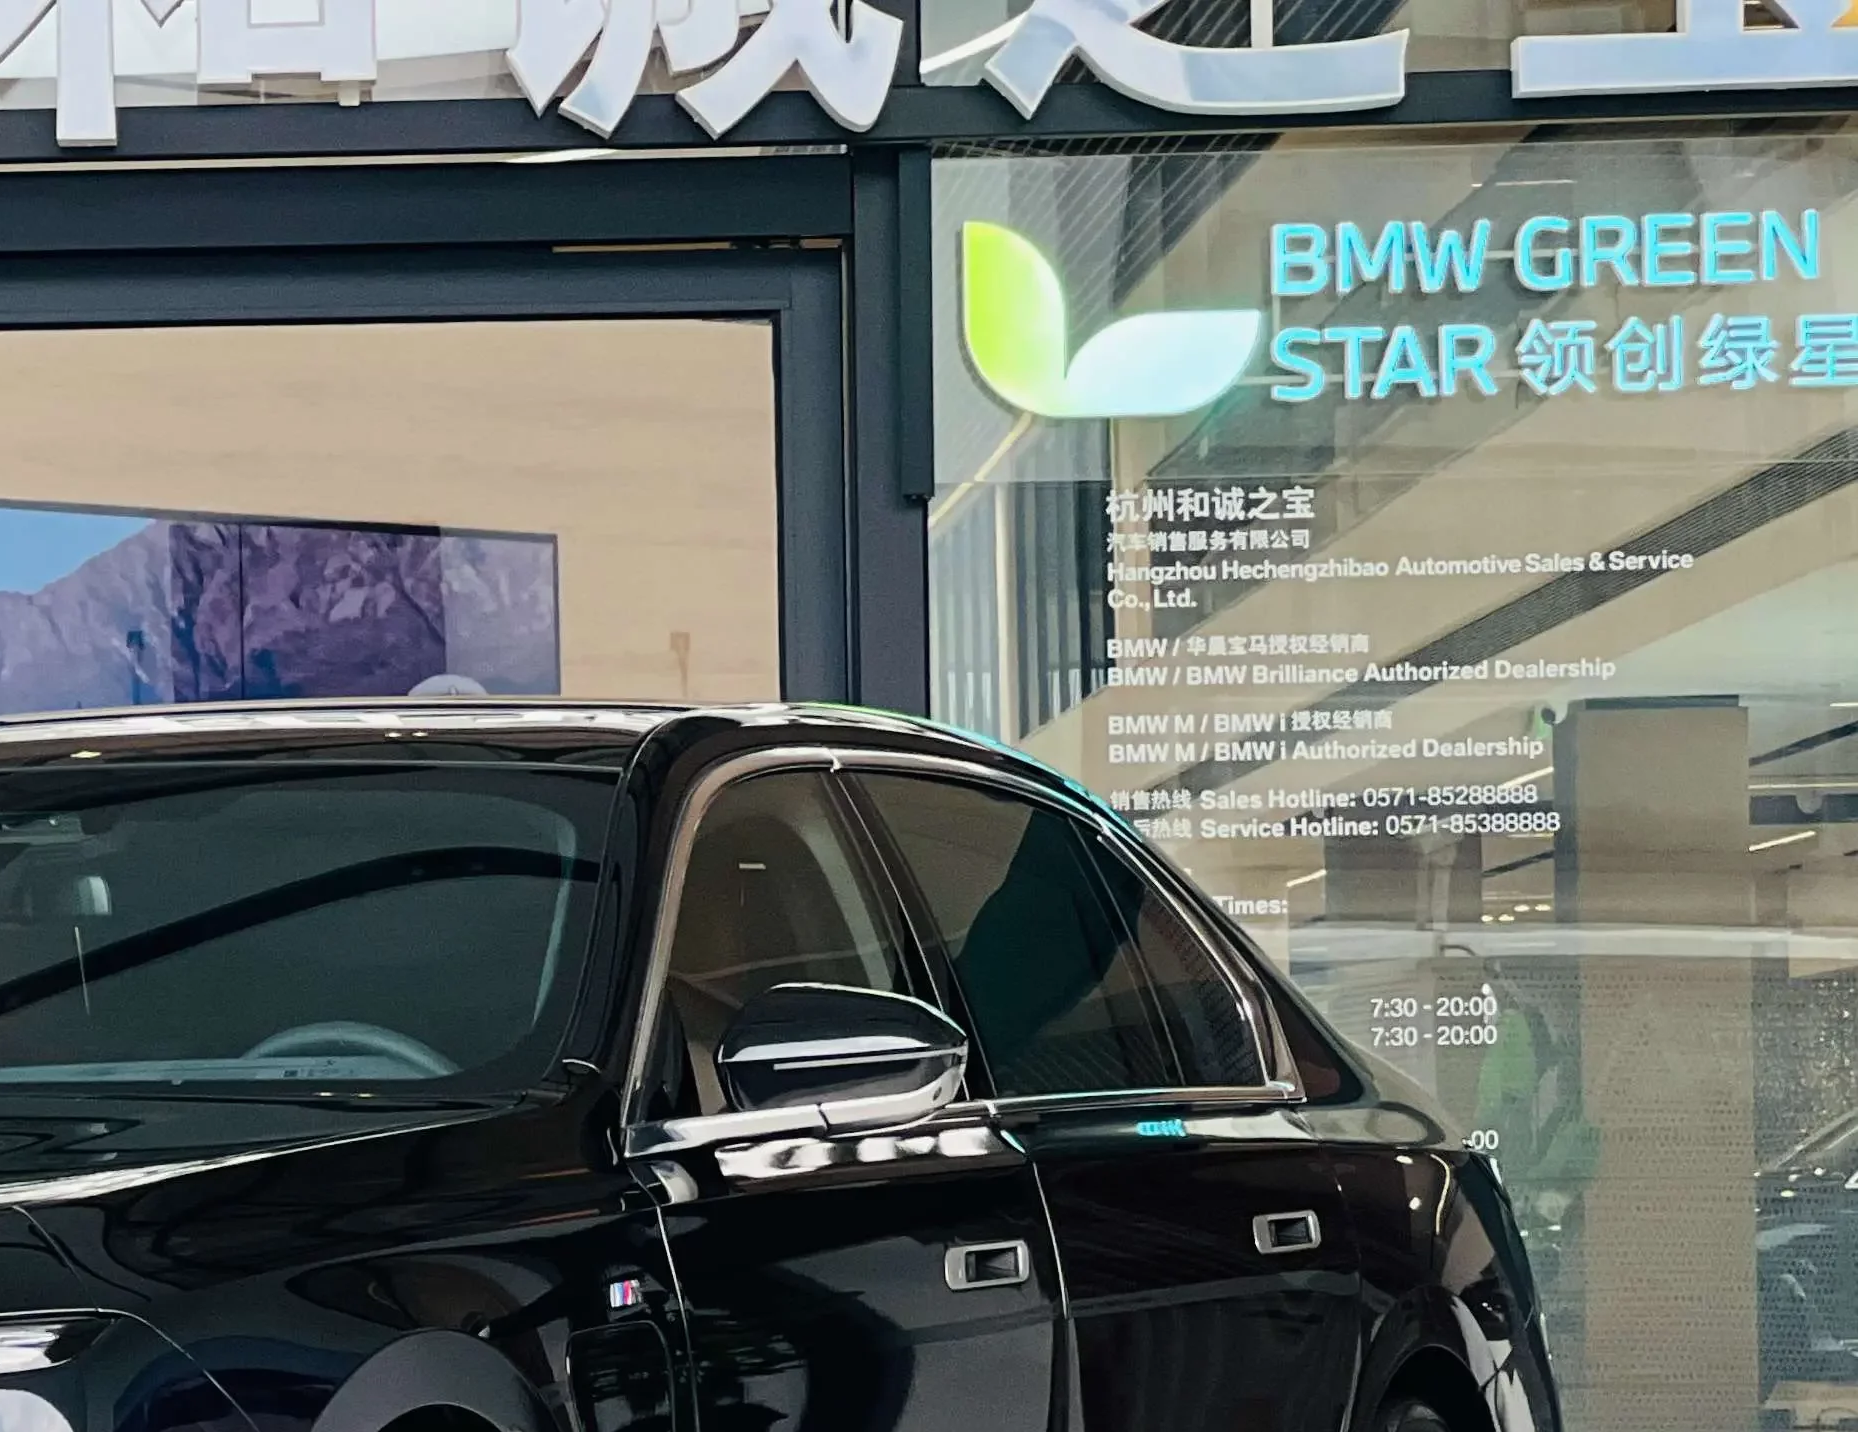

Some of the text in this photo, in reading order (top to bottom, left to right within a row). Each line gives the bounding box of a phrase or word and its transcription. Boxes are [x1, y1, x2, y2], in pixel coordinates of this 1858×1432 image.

[1270, 209, 1819, 296] BMW GREEN
[1270, 312, 1858, 401] STAR 领创绿星
[1106, 486, 1315, 523] 杭州和诚之宝
[1106, 529, 1310, 552] 汽车销售服务有限公司
[1107, 549, 1694, 586] Hangzhou Hechengzhibao Automotive Sales & Service
[1107, 638, 1167, 659] BMW
[1187, 634, 1370, 656] 华晨宝马授权经销商
[1107, 667, 1167, 687] BMW
[1187, 665, 1246, 685] BMW
[1253, 663, 1359, 684] Brilliance
[1363, 660, 1489, 682] Authorized
[1494, 657, 1616, 681] Dealership
[1108, 715, 1167, 735] BMW
[1174, 714, 1195, 734] M
[1214, 713, 1274, 733] BMW
[1291, 711, 1392, 732] 授权经销商
[1108, 743, 1167, 763] BMW
[1174, 742, 1195, 762] M
[1214, 741, 1274, 762] BMW
[1293, 739, 1416, 760] Authorized
[1423, 737, 1543, 759] Dealership
[1110, 783, 1538, 811] 销售热线 Sales Hotline: 0571-85288888
[1200, 817, 1285, 839] Service
[1290, 815, 1379, 838] Hotline:
[1385, 811, 1561, 836] 0571-85388888
[1212, 895, 1288, 915] Times:
[1370, 998, 1418, 1018] 7:30
[1436, 996, 1498, 1017] 20:00
[1370, 1027, 1419, 1047] 7:30
[1436, 1025, 1498, 1046] 20:00
